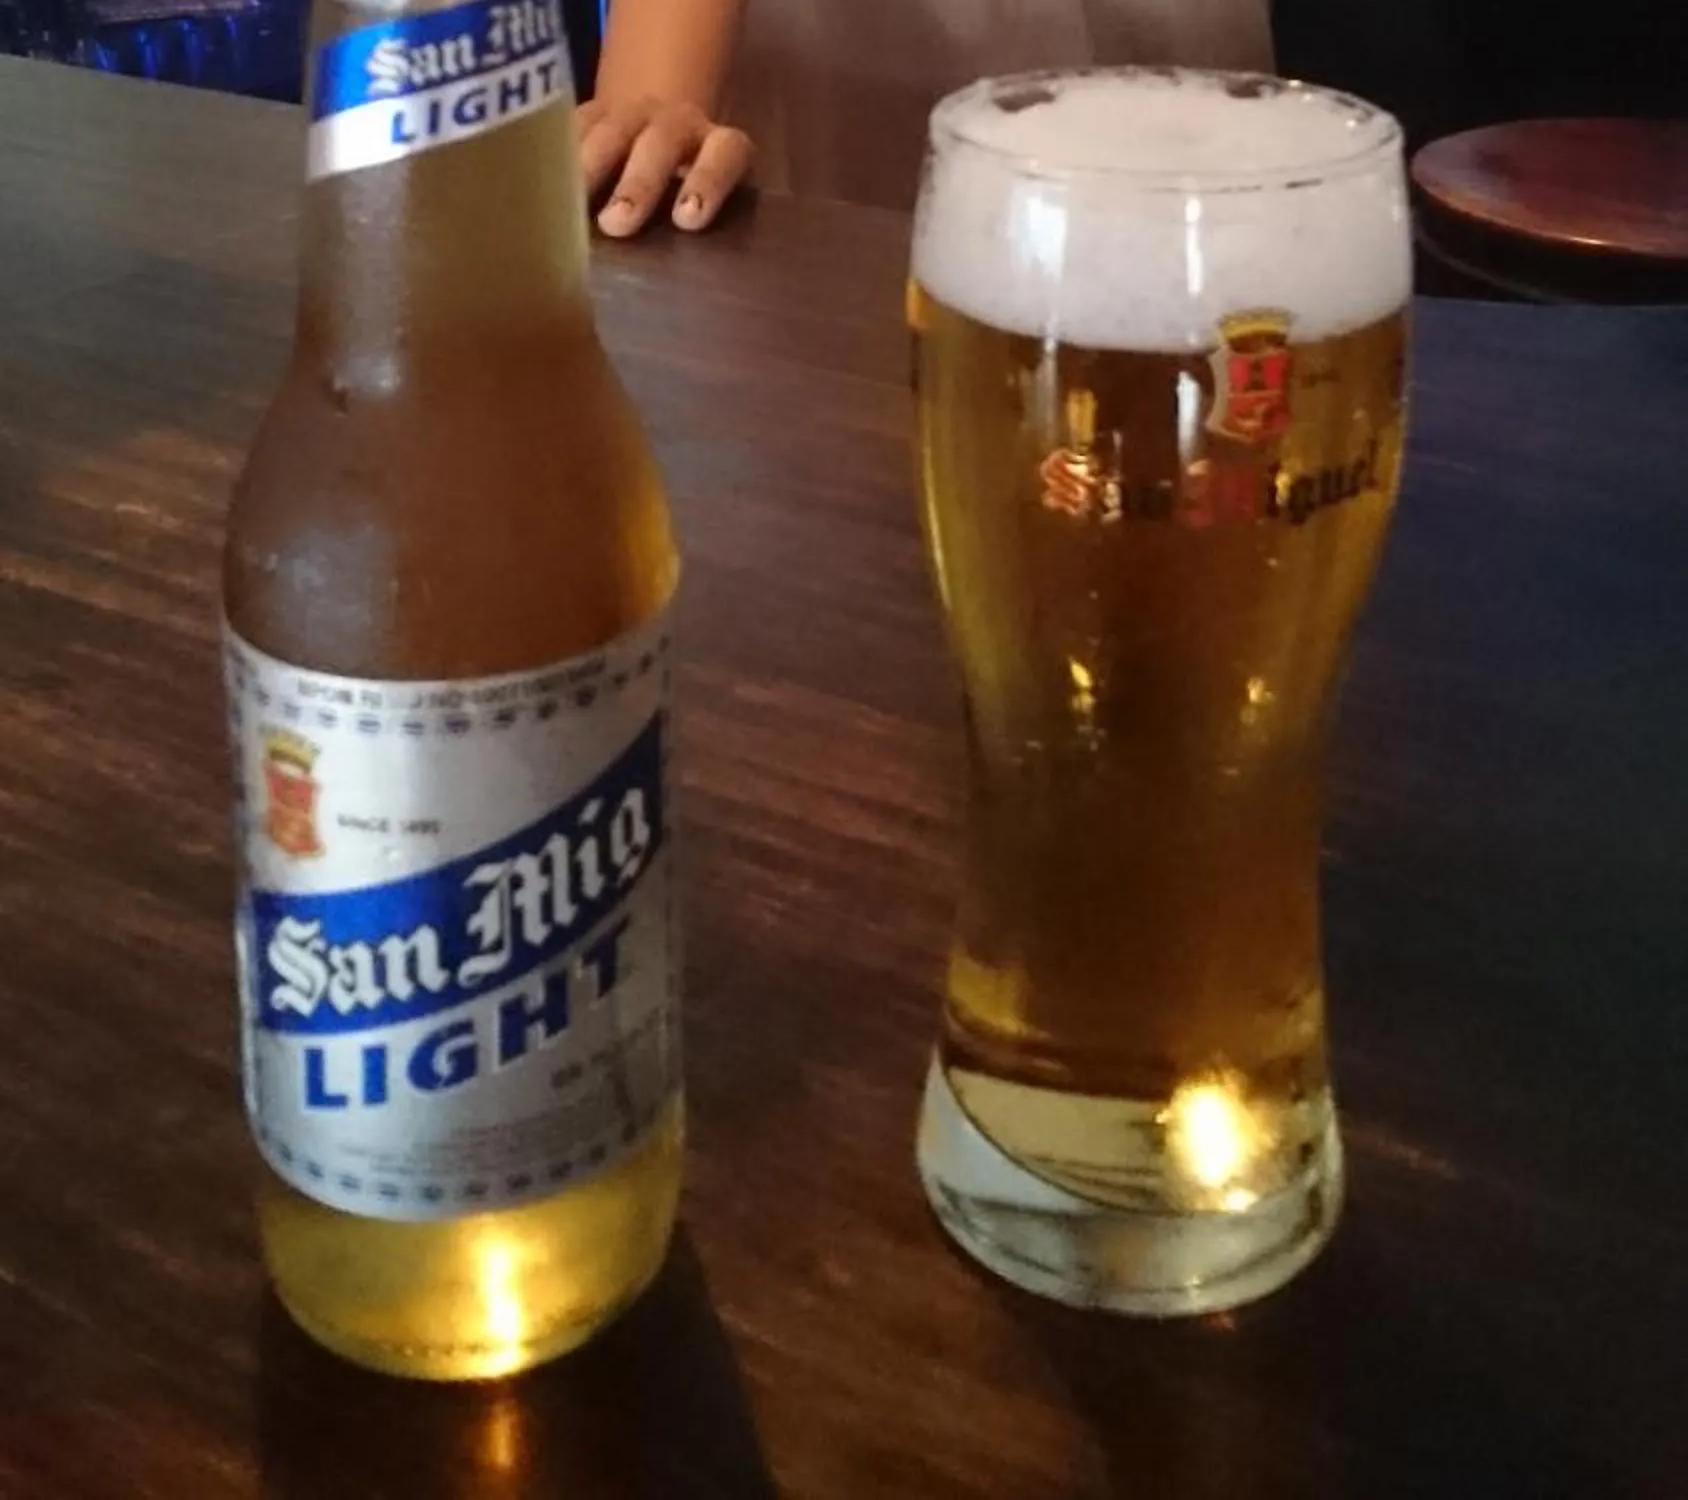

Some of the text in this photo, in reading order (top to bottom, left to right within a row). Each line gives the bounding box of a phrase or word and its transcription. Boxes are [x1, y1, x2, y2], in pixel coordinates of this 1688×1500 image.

[367, 36, 476, 96] San
[390, 60, 557, 145] LIGHT
[266, 787, 651, 1018] San Mig
[304, 918, 624, 1109] LIGHT
